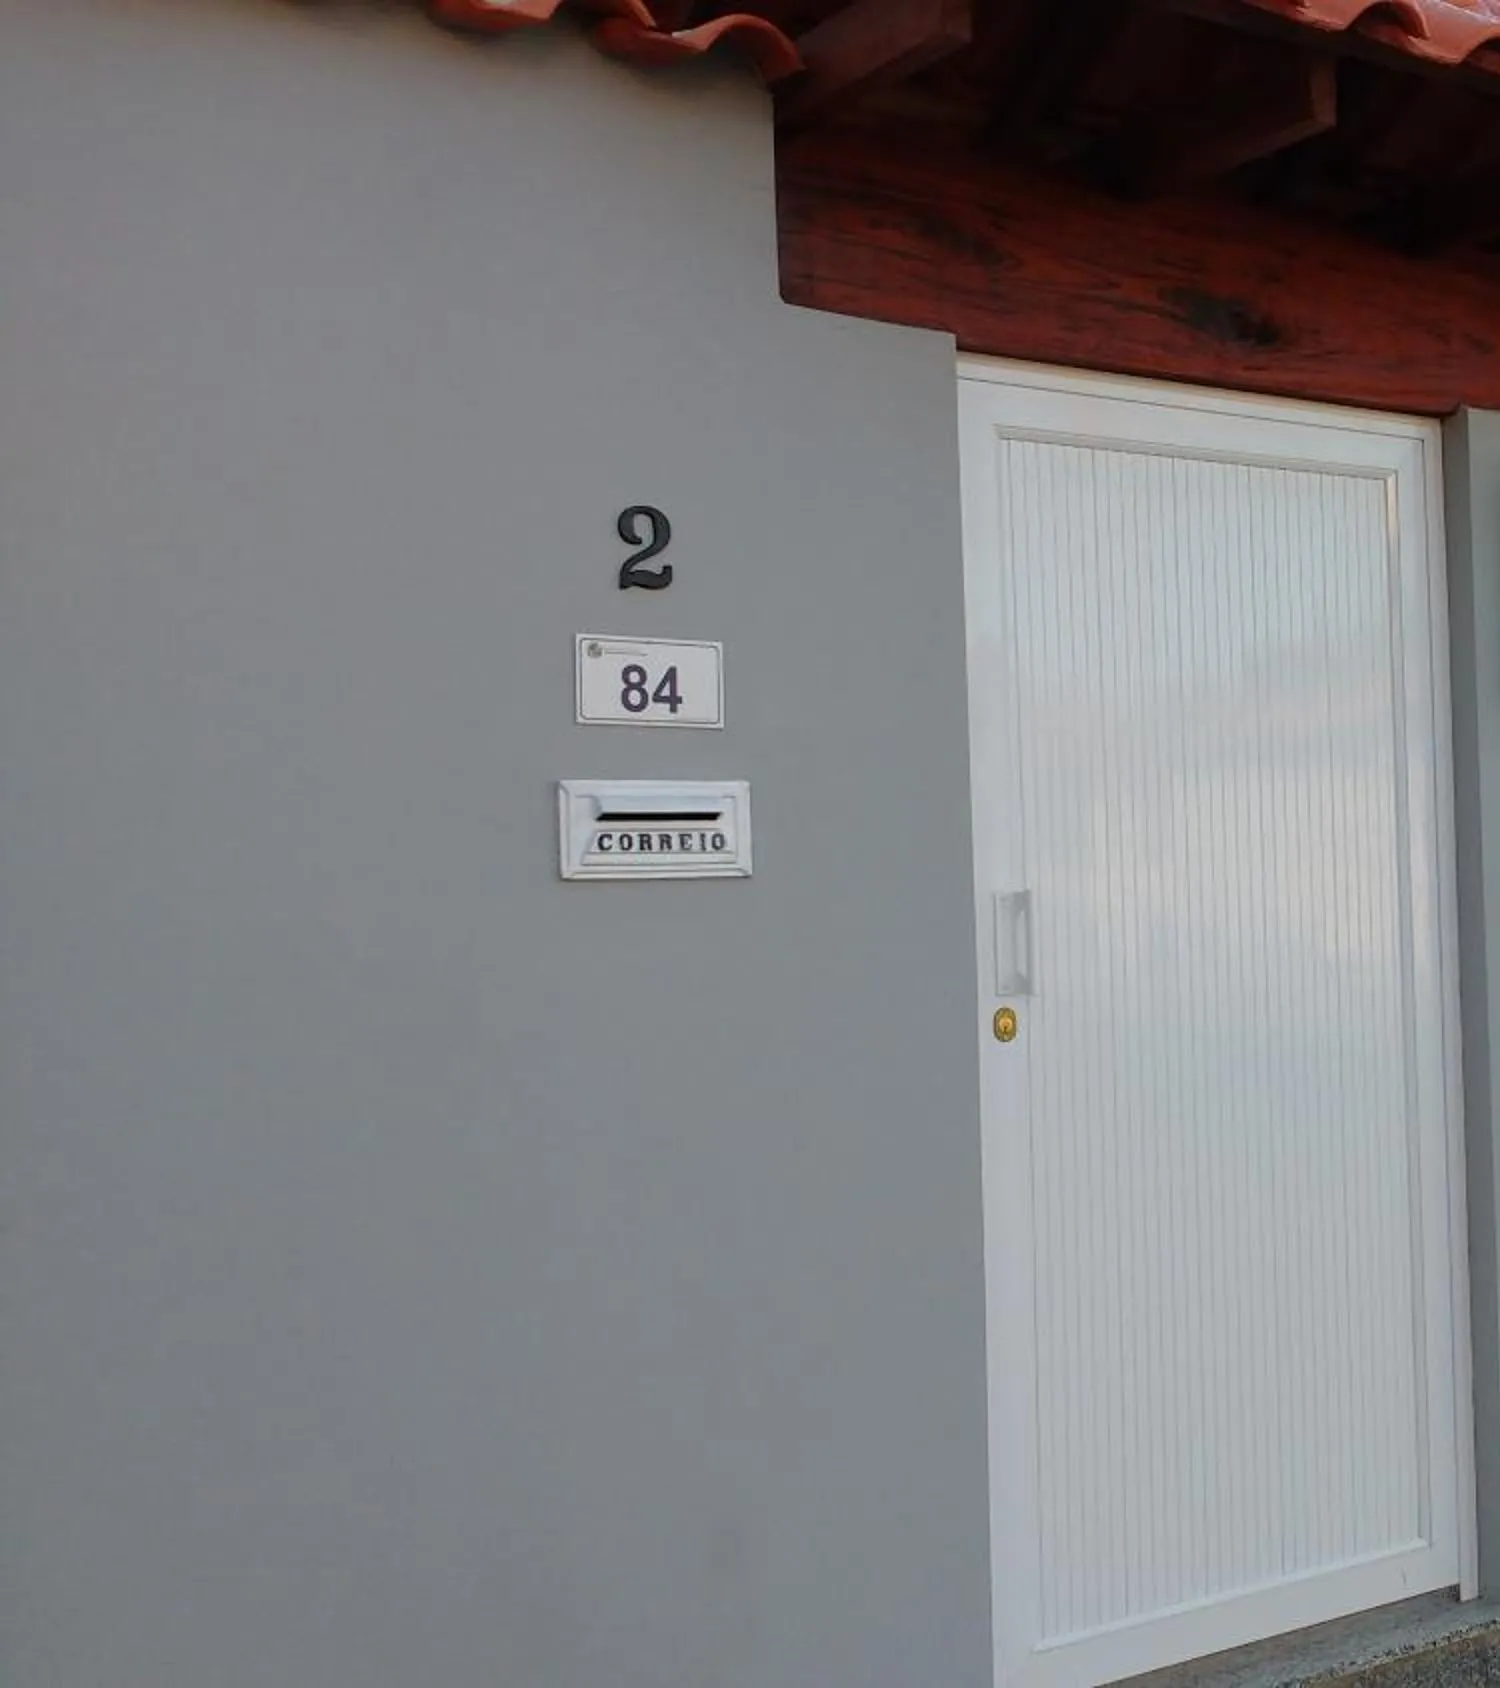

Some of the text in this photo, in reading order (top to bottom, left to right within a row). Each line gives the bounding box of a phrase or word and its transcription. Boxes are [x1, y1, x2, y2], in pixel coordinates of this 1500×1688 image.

[618, 506, 673, 590] 2
[621, 664, 683, 713] 84
[597, 833, 726, 851] CORREIO
